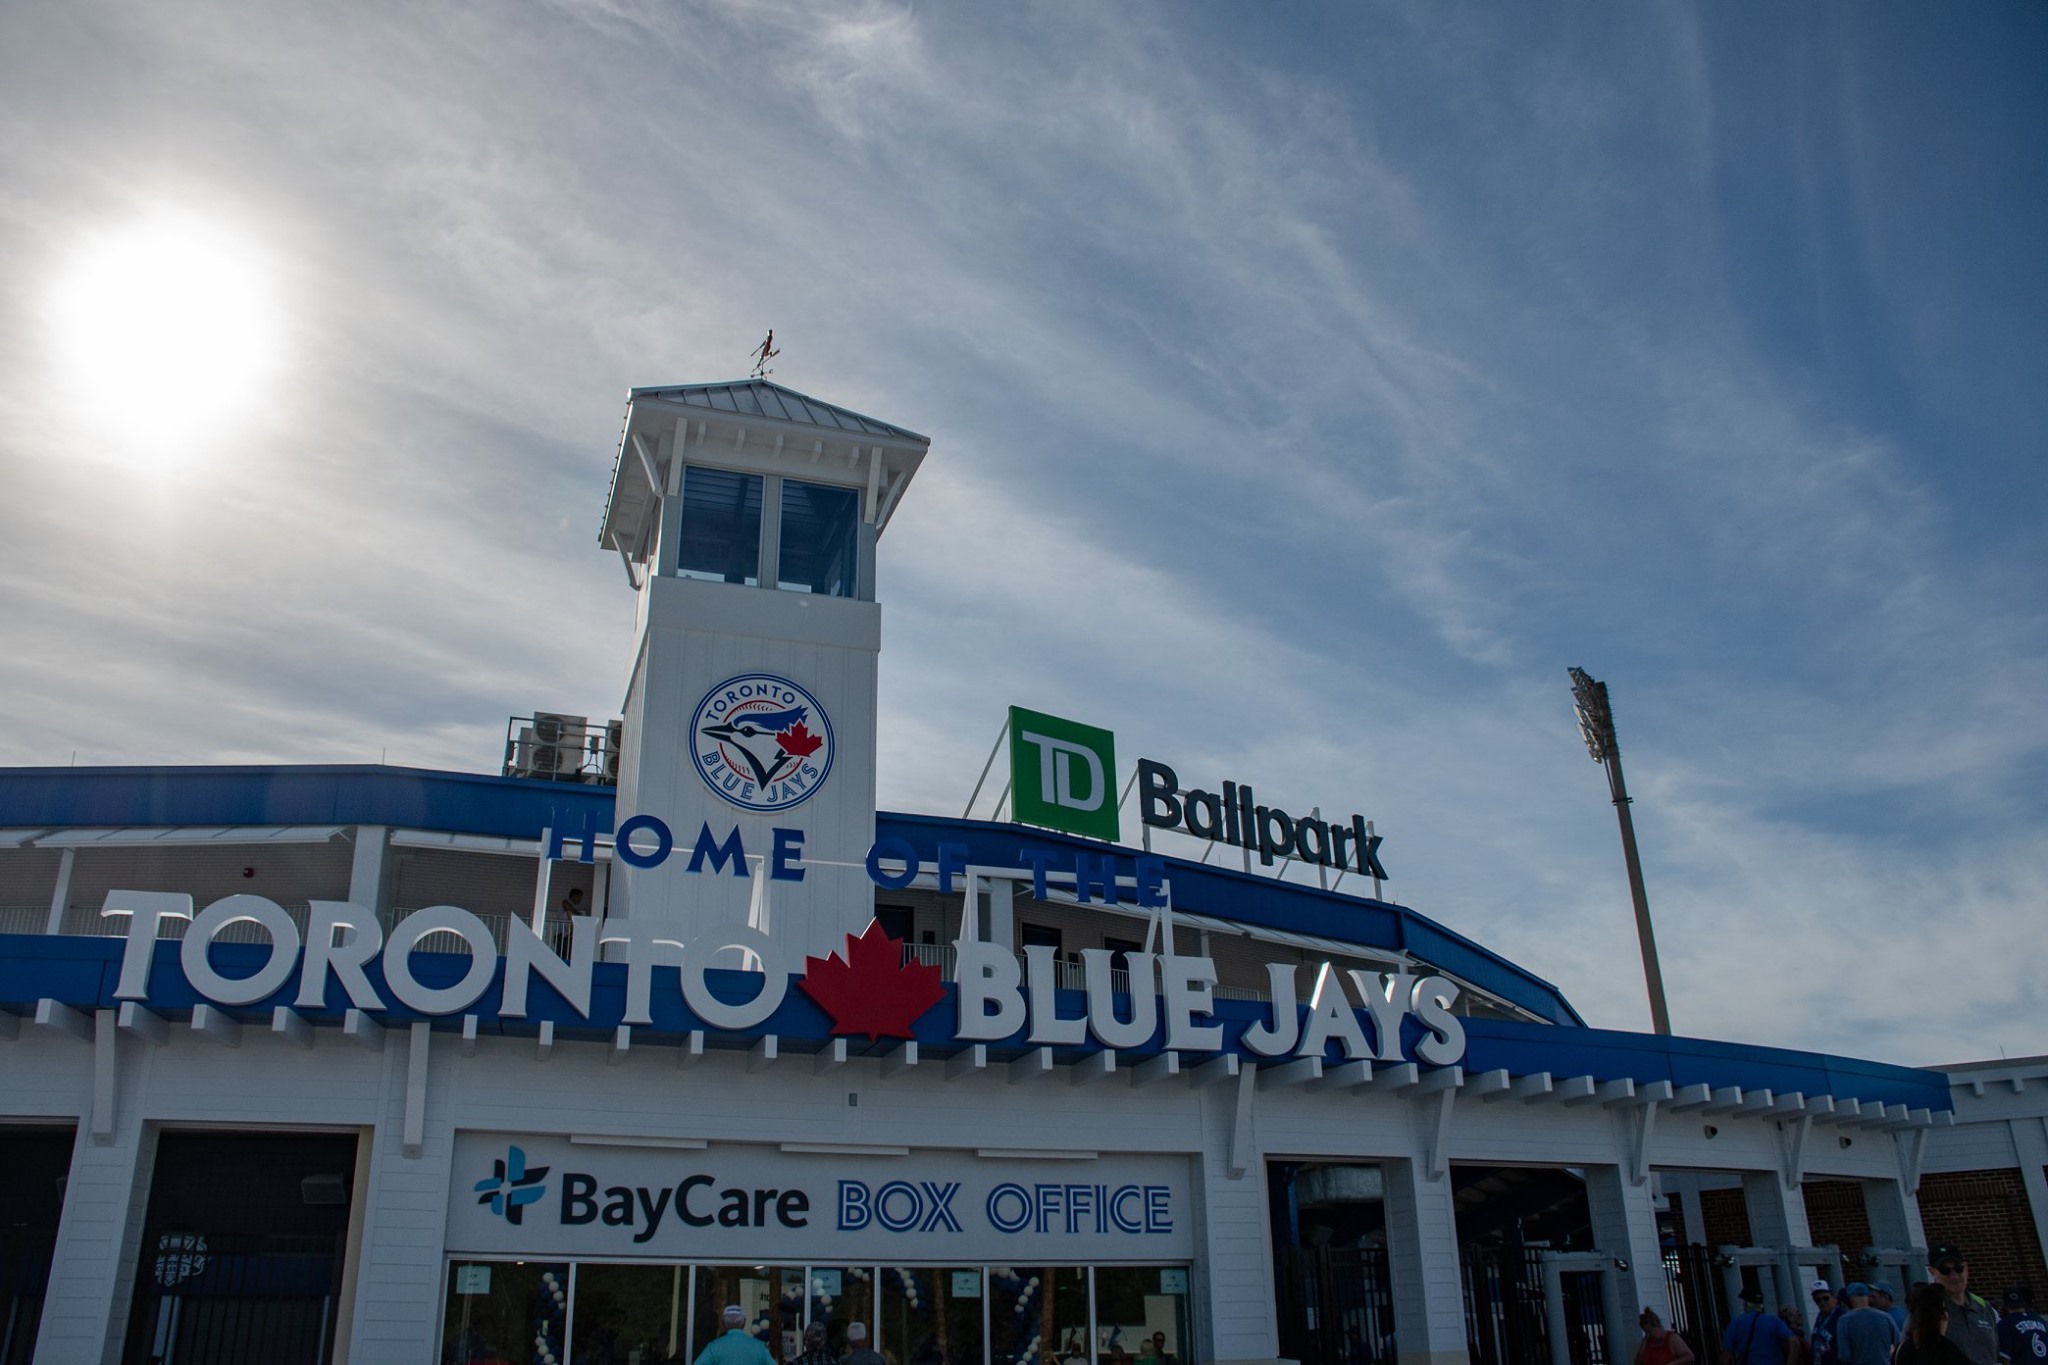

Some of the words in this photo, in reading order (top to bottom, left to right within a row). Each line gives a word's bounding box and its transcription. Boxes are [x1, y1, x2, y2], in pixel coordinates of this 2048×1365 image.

[705, 684, 795, 721] TORONTO
[702, 751, 755, 800] BLUE
[767, 763, 818, 802] JAYS
[1022, 730, 1105, 812] TD
[1138, 758, 1389, 880] Ballpark
[546, 806, 806, 882] HOME
[866, 838, 970, 893] OF
[1019, 848, 1168, 908] THE
[101, 890, 789, 1030] TORONTO
[952, 939, 1224, 1050] BLUE
[1240, 961, 1466, 1066] JAYS
[560, 1173, 810, 1243] BayCare
[837, 1180, 963, 1233] BOX
[986, 1183, 1173, 1234] OFFICE
[2032, 1332, 2047, 1358] 6
